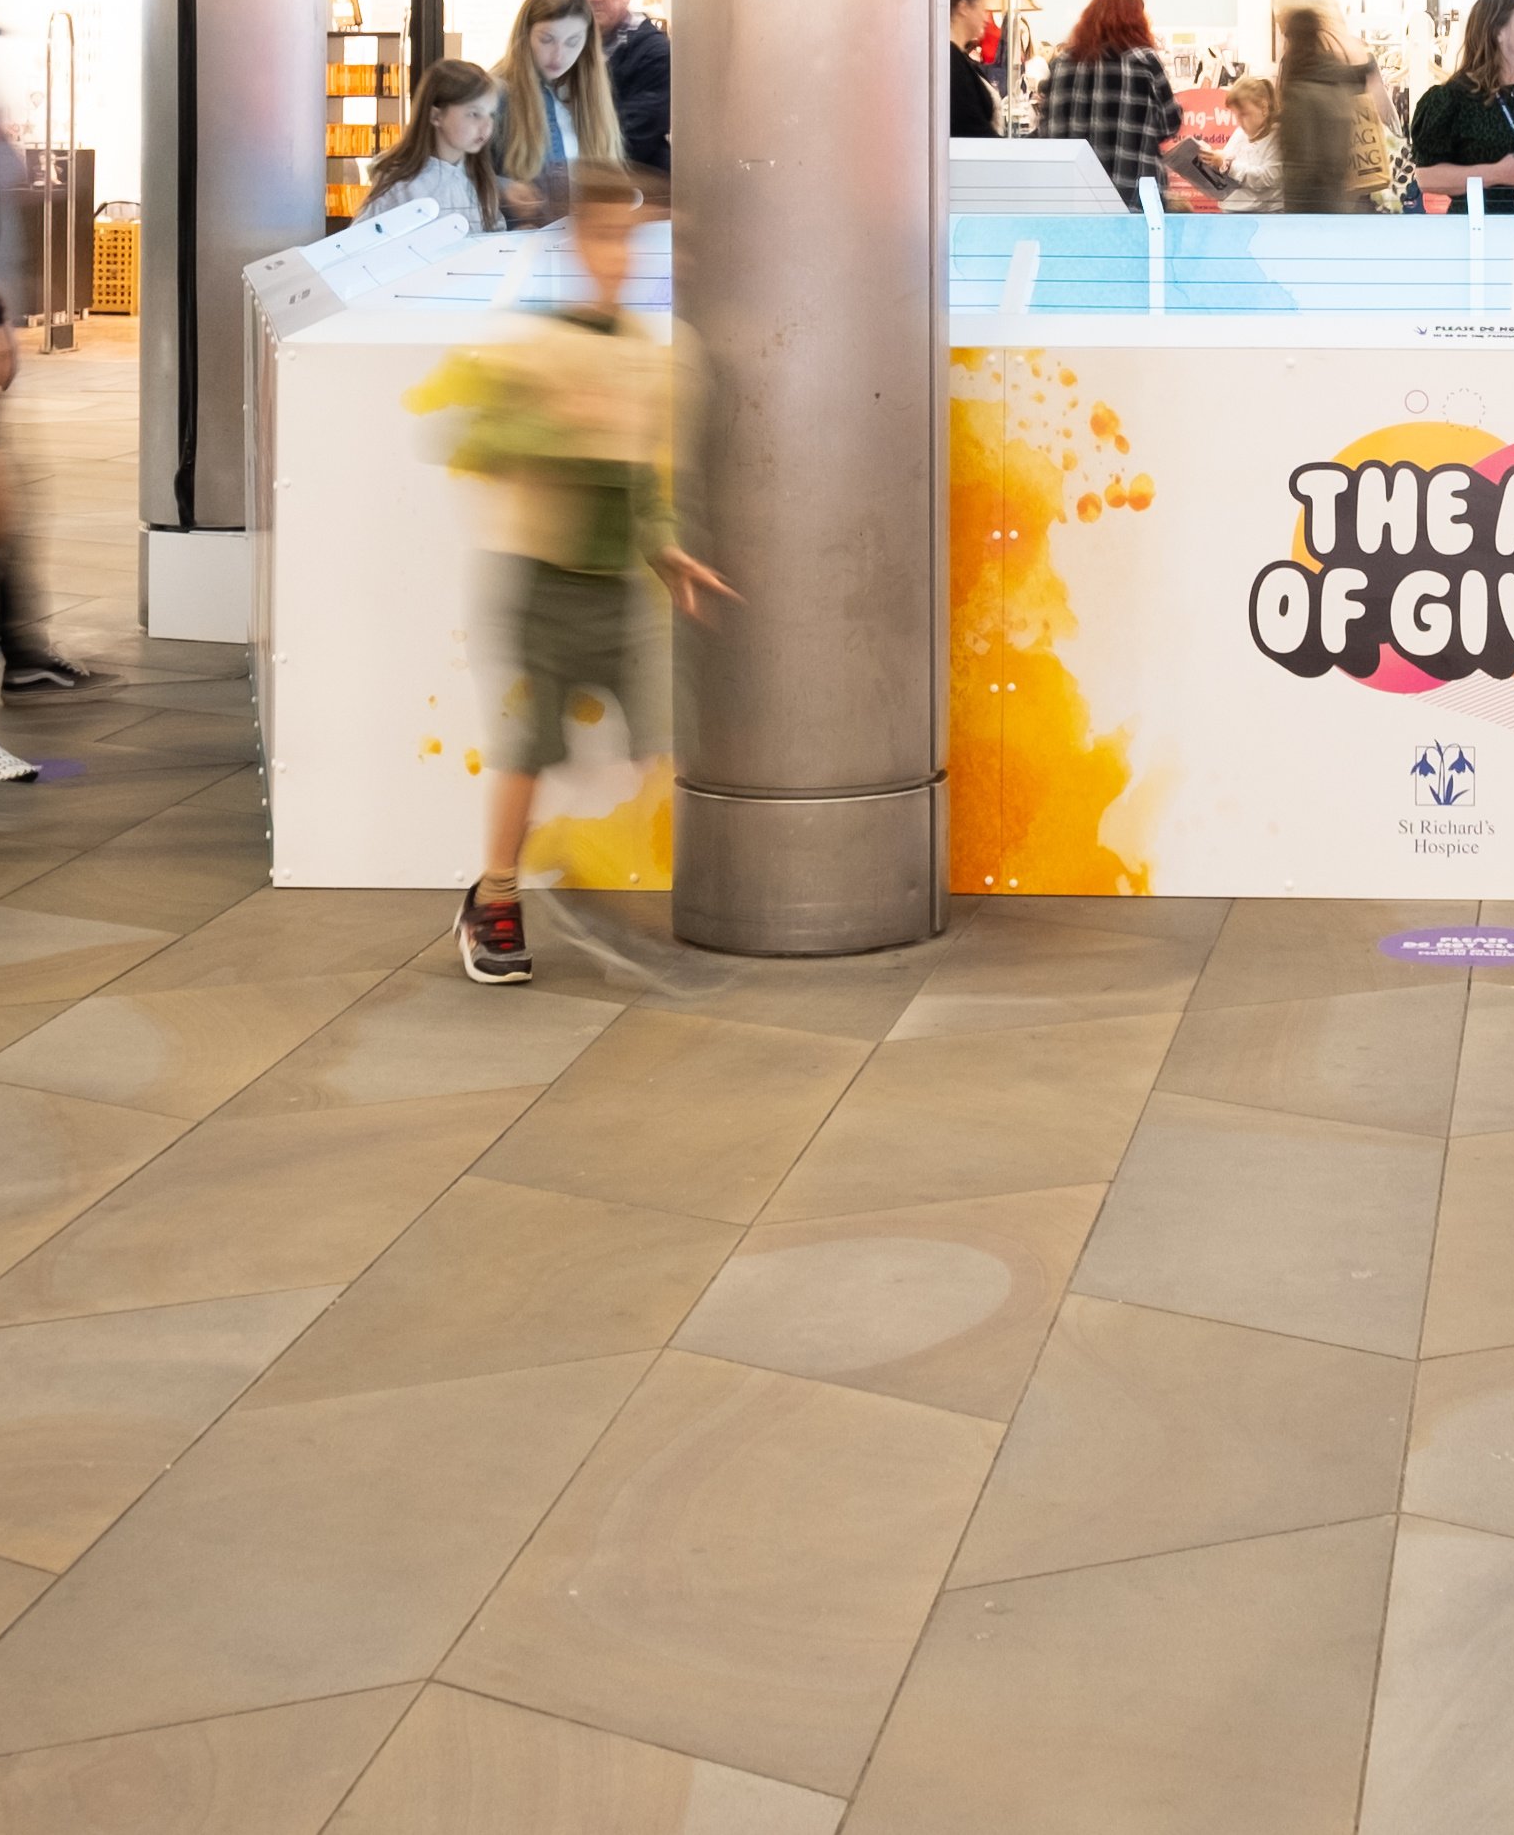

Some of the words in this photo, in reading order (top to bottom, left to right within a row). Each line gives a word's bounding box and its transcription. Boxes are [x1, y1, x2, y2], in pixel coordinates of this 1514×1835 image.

[1294, 465, 1476, 558] THE
[1255, 565, 1370, 656] OF
[1399, 822, 1412, 834] St
[1421, 821, 1494, 834] Richard's
[1415, 839, 1478, 857] Hospice
